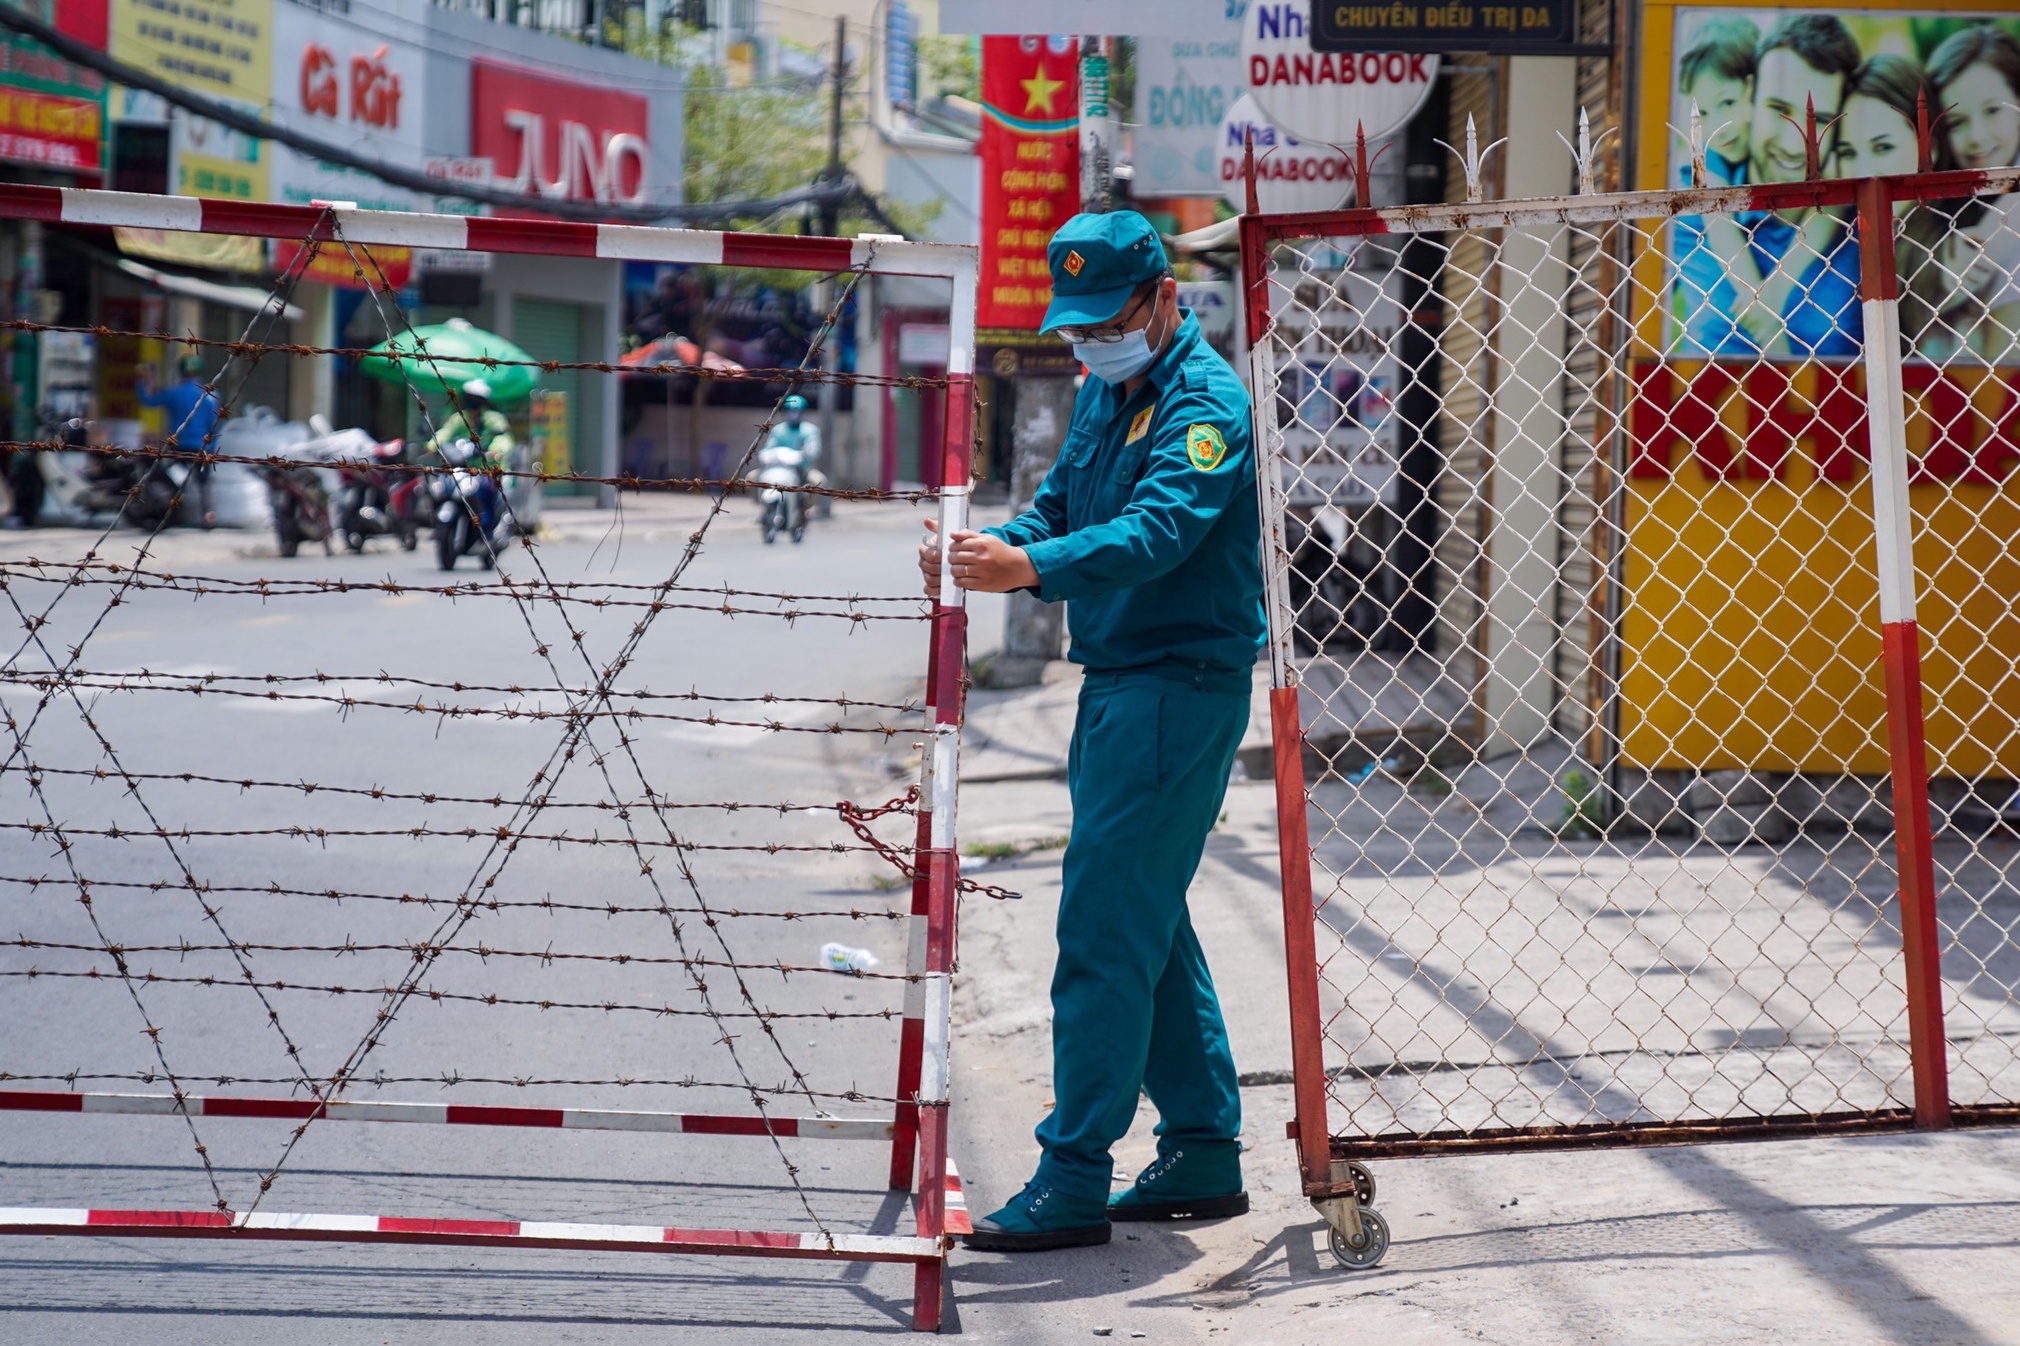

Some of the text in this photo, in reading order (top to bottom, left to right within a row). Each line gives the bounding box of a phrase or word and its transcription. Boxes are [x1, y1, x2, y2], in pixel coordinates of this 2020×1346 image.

[1258, 4, 1310, 39] Nh
[1335, 1, 1417, 27] CHUYÊN
[1481, 7, 1516, 31] TRỊ
[1521, 7, 1551, 27] DA
[1250, 53, 1429, 86] DANABOOK
[492, 109, 648, 206] JUNO
[1221, 157, 1354, 181] DANABOOK
[1027, 258, 1050, 277] NA
